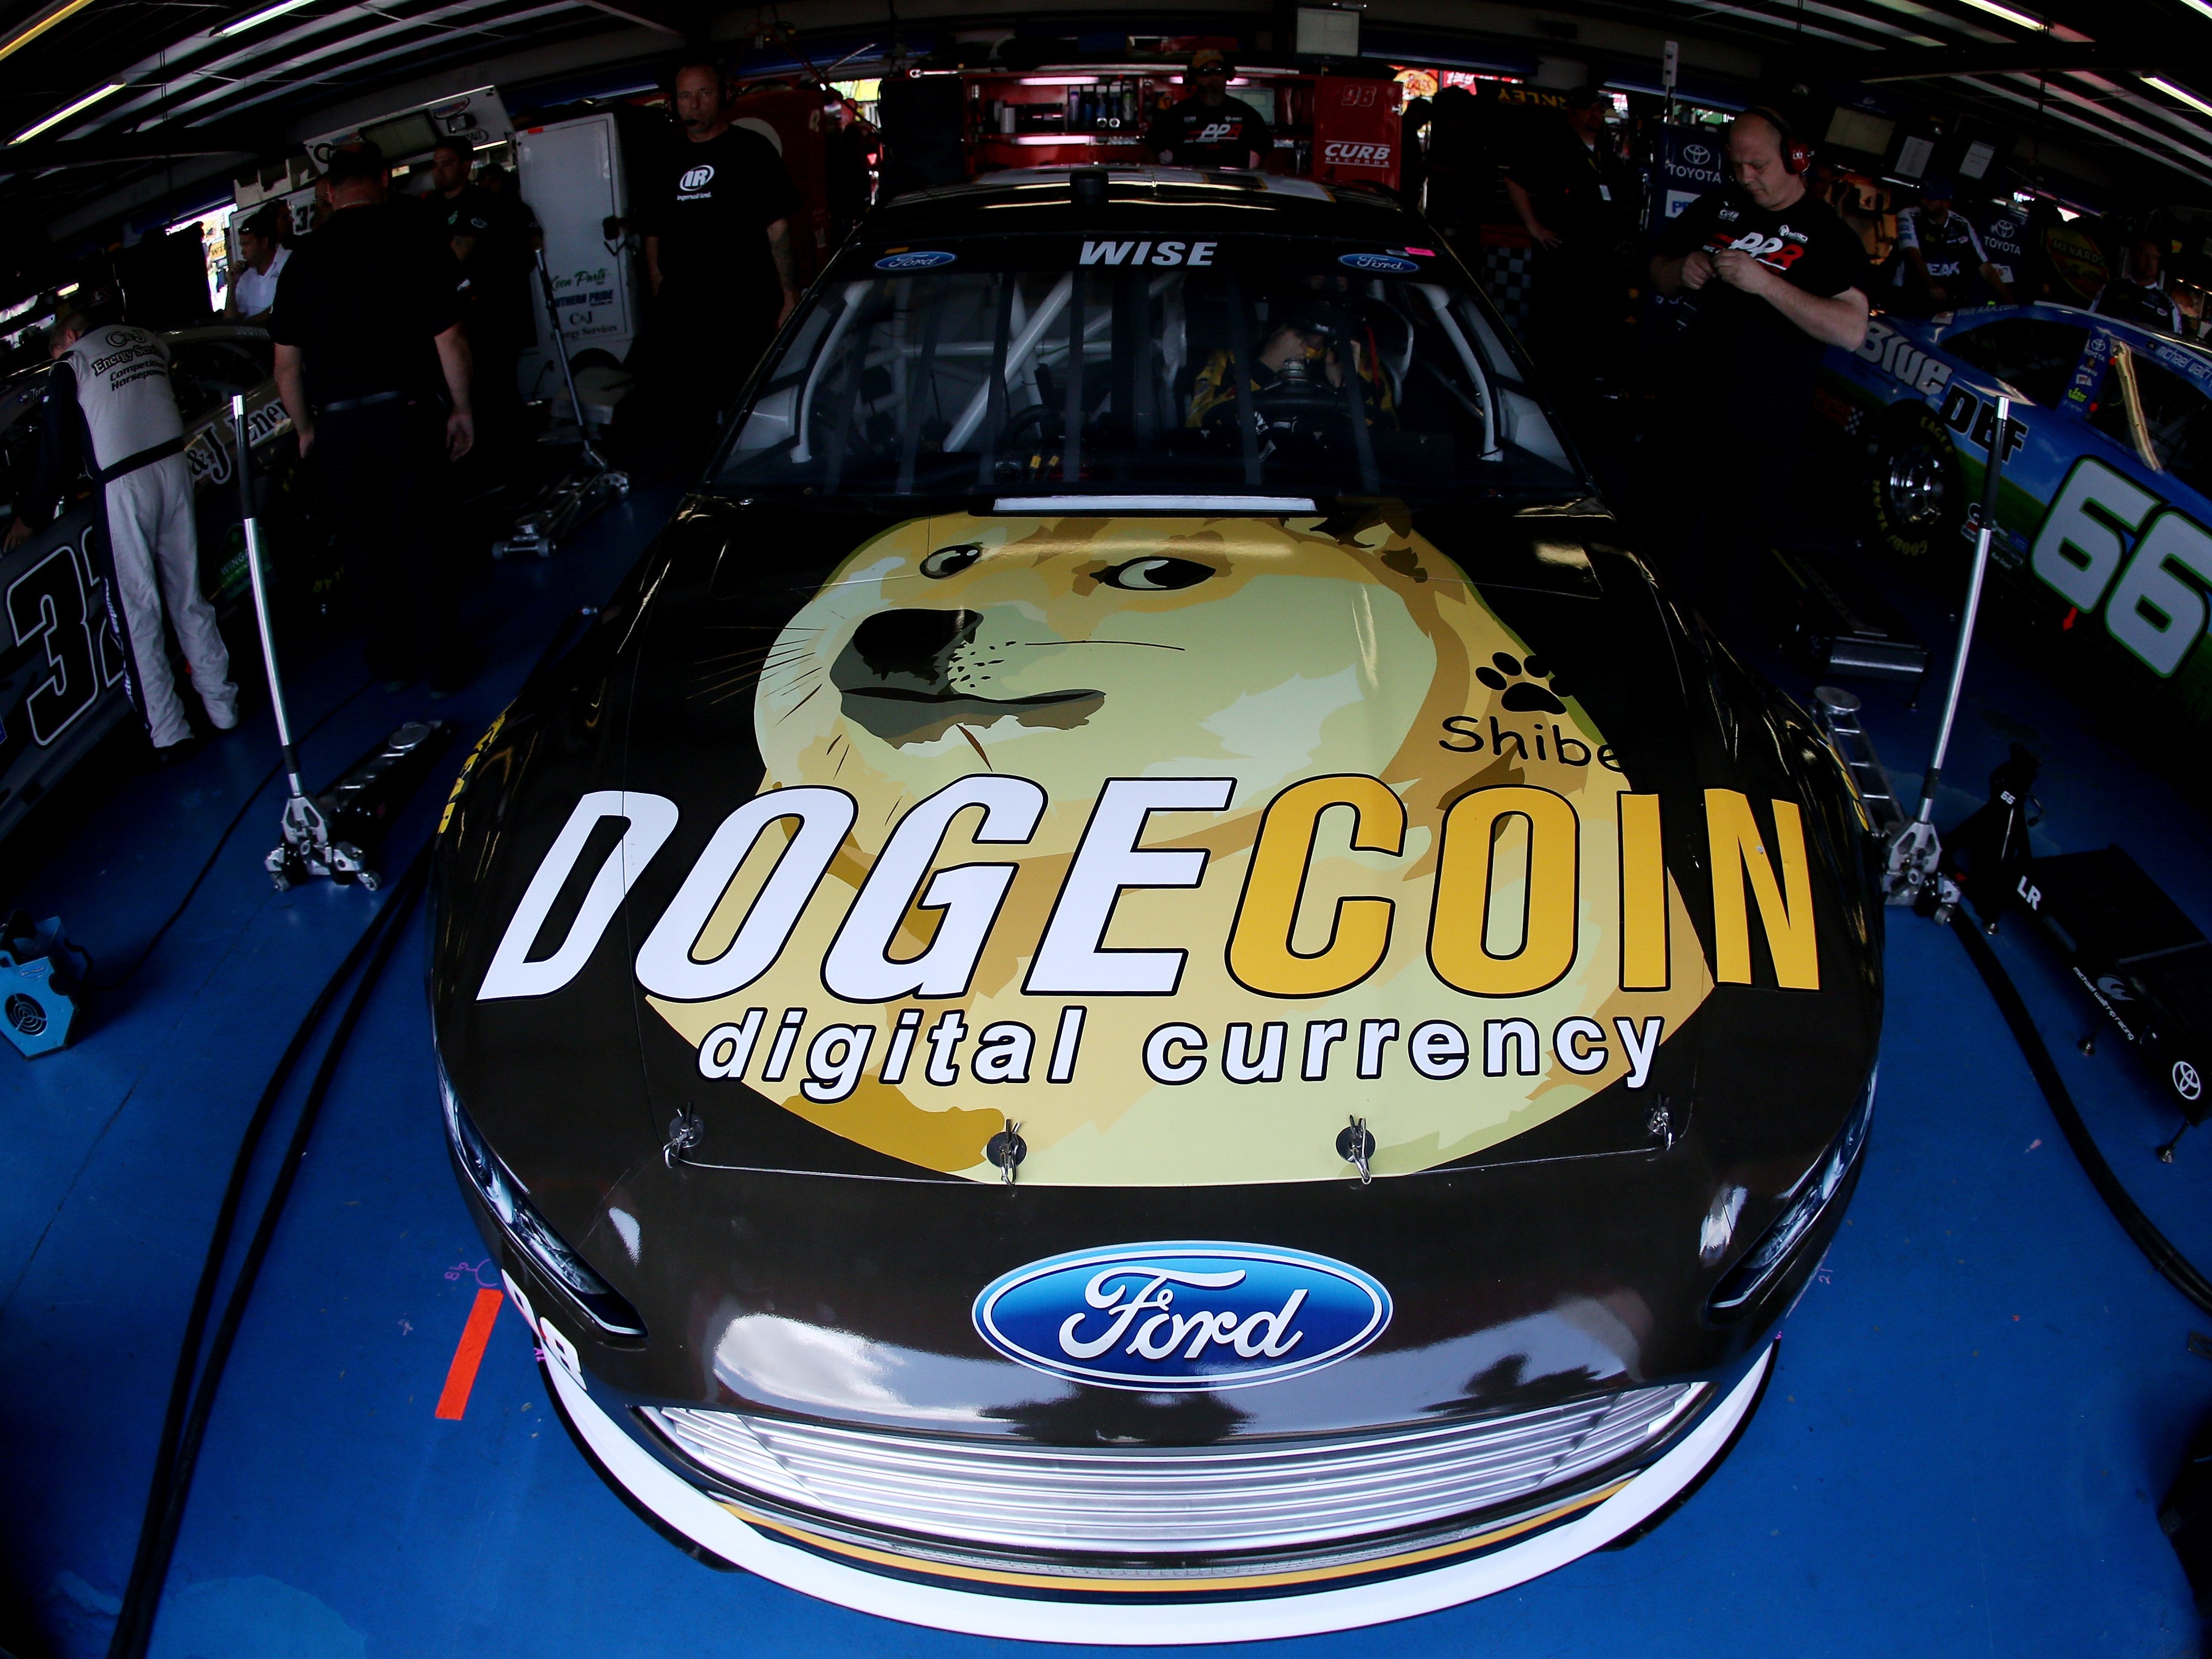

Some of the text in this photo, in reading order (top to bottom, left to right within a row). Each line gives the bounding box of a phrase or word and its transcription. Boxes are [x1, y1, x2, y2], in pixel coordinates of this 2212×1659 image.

[1324, 144, 1391, 160] CURB
[1668, 163, 1722, 184] TOYOTA
[1079, 241, 1218, 266] WISE
[1983, 236, 2021, 256] TOYOTA
[888, 254, 940, 268] Ford
[1356, 256, 1404, 271] Ford
[91, 349, 133, 377] Energy
[1854, 320, 1953, 396] Blue
[2030, 454, 2212, 680] 66
[1439, 715, 1626, 773] Shibe
[474, 773, 1823, 1004] DOGECOIN
[2017, 875, 2042, 911] LR
[2115, 1017, 2135, 1041] racing
[696, 1006, 1666, 1104] digital currency
[1059, 1267, 1307, 1362] Ford
